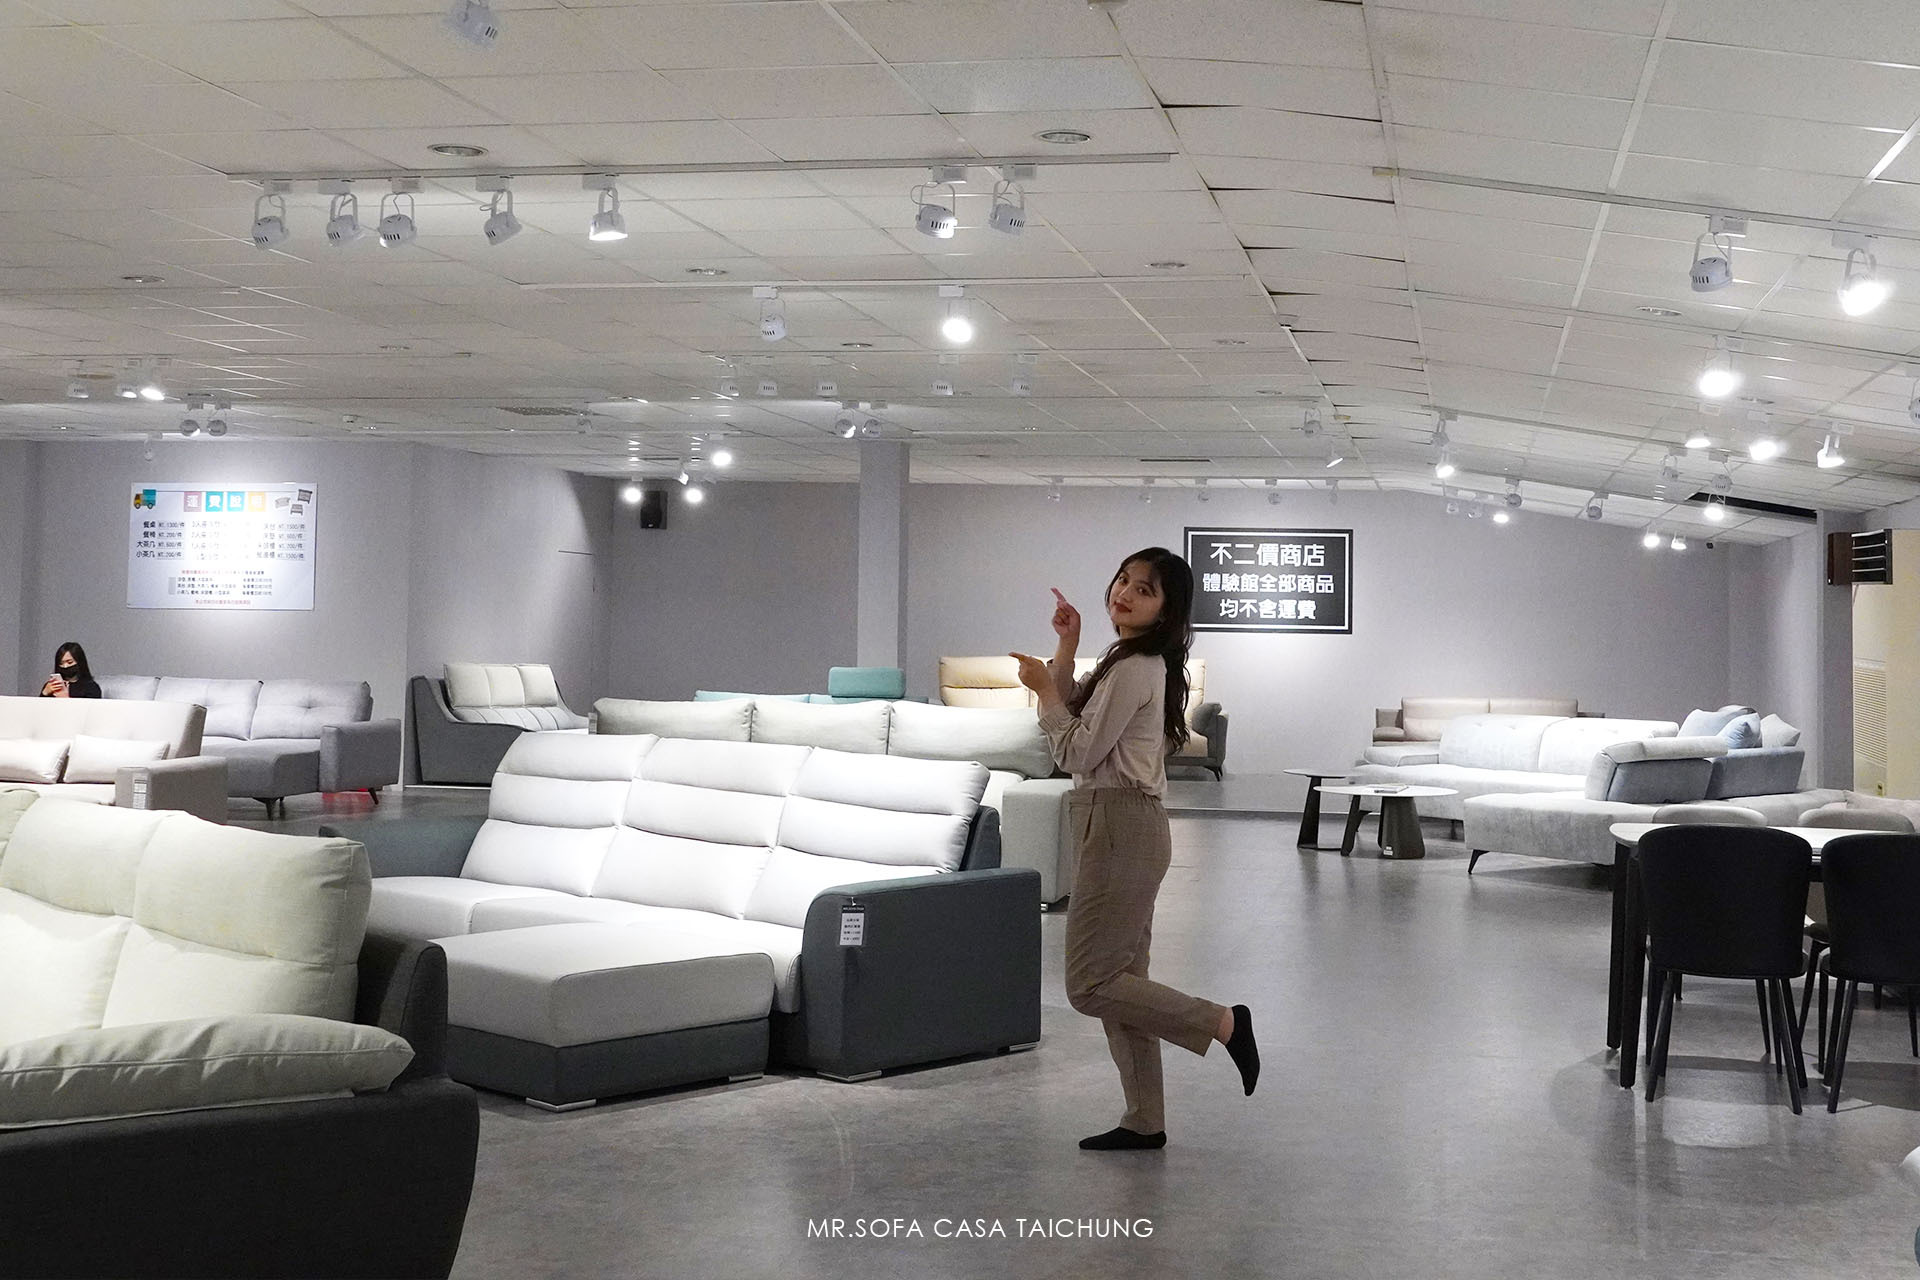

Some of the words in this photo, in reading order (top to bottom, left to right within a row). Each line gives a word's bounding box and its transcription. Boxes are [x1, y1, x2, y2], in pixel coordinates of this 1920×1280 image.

[135, 550, 156, 558] 小茶几
[136, 540, 156, 548] 大茶几
[1209, 543, 1325, 567] 不二價商店
[1202, 573, 1335, 594] 體驗館全部商品
[1219, 599, 1318, 620] 均不含運費
